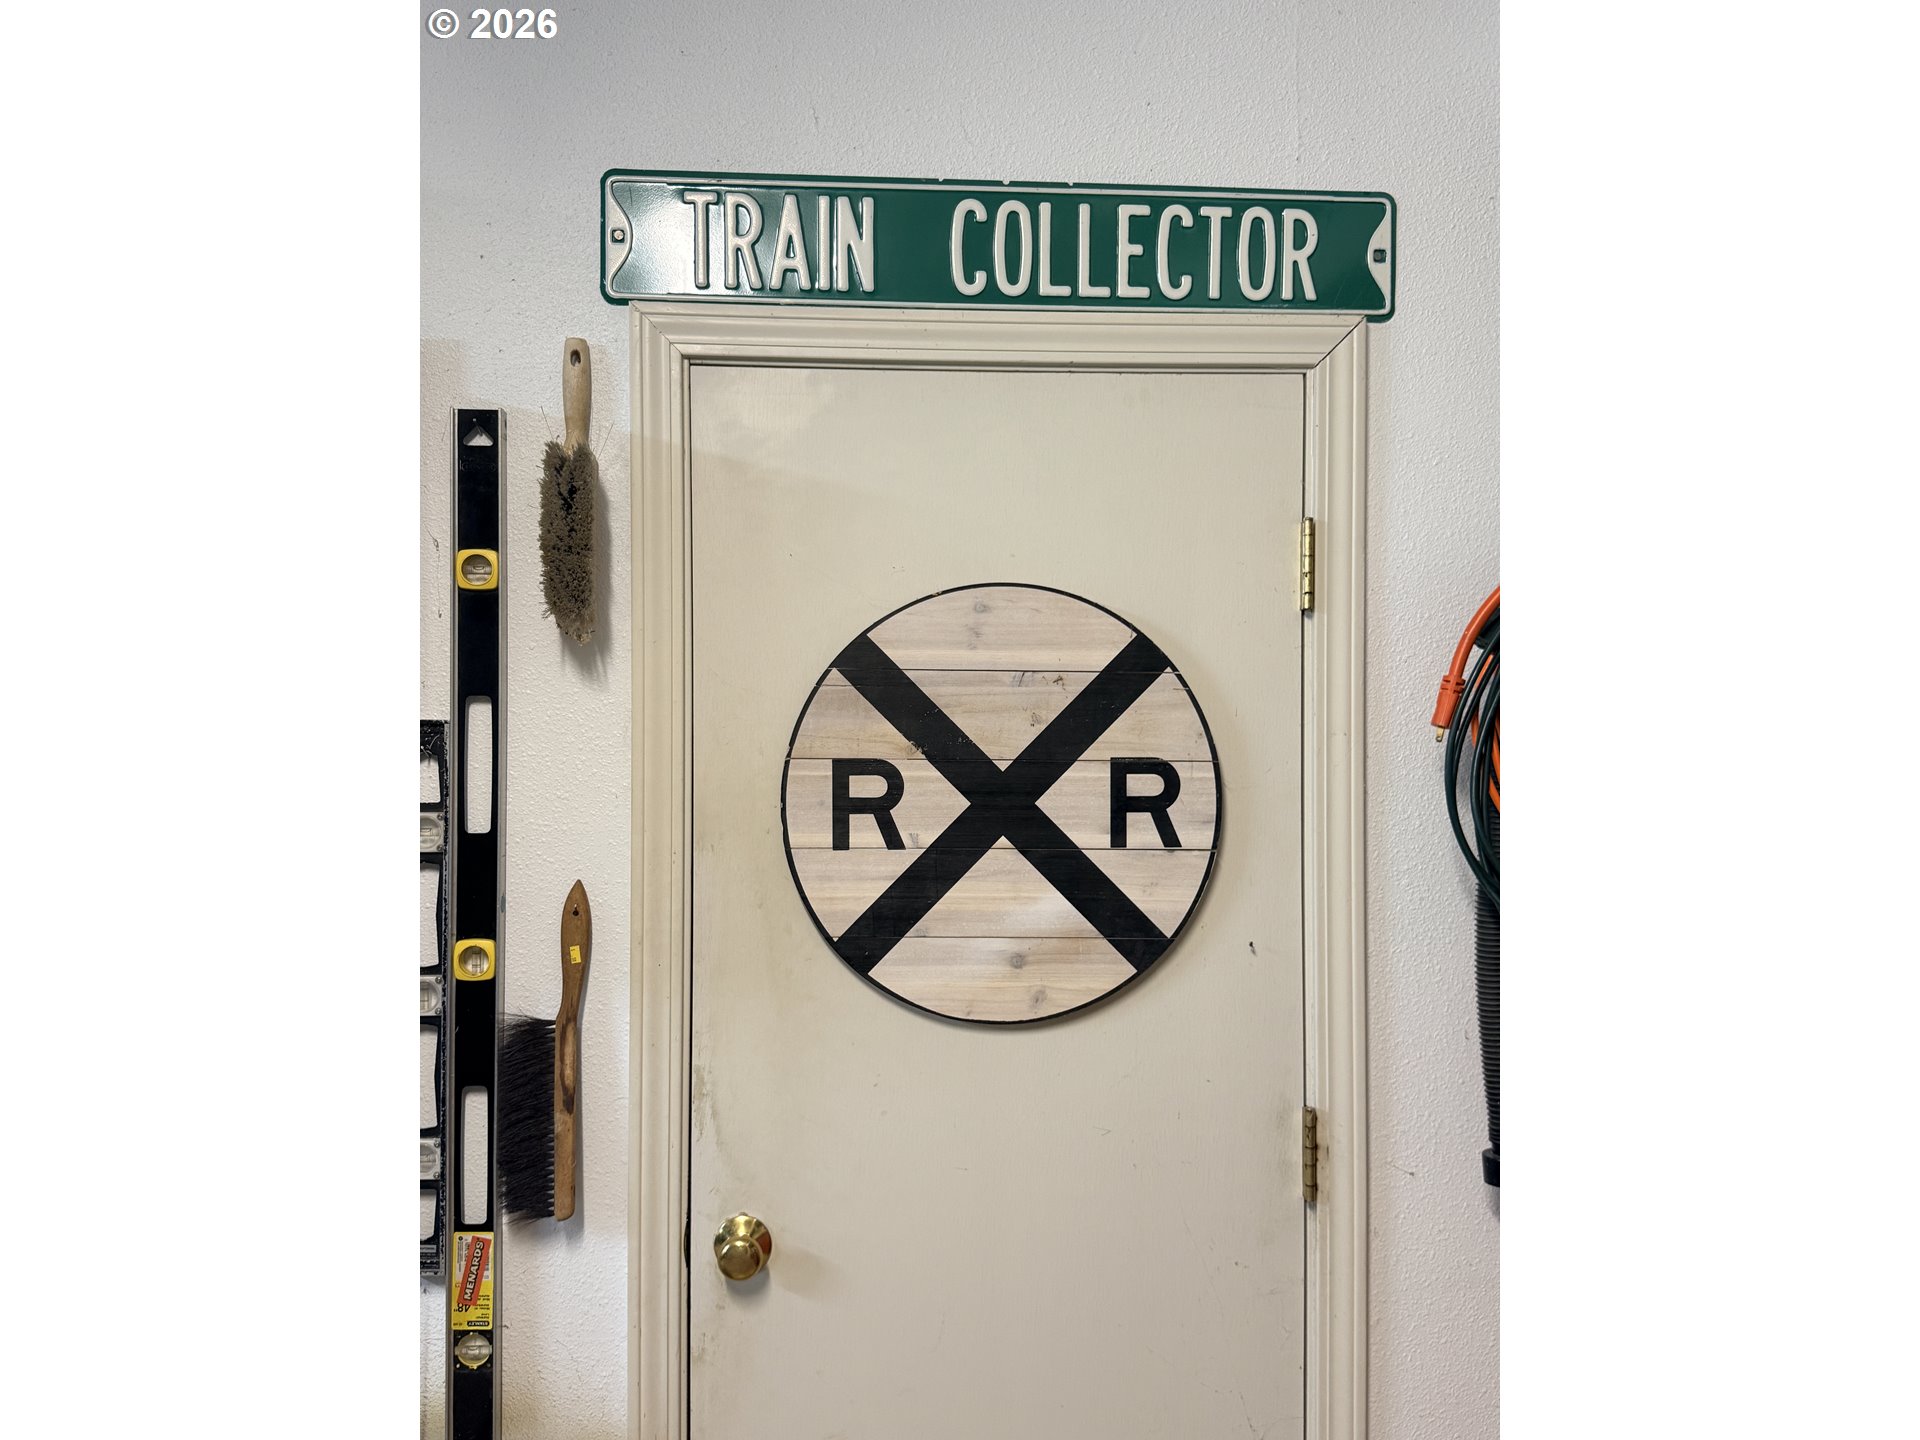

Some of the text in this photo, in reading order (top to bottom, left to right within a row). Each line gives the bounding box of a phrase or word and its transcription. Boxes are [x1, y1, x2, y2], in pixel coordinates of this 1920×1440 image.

[683, 190, 1319, 301] TRAIN COLLECTOR
[831, 758, 907, 851] R
[1110, 756, 1183, 849] R
[463, 1240, 485, 1301] MENARDS
